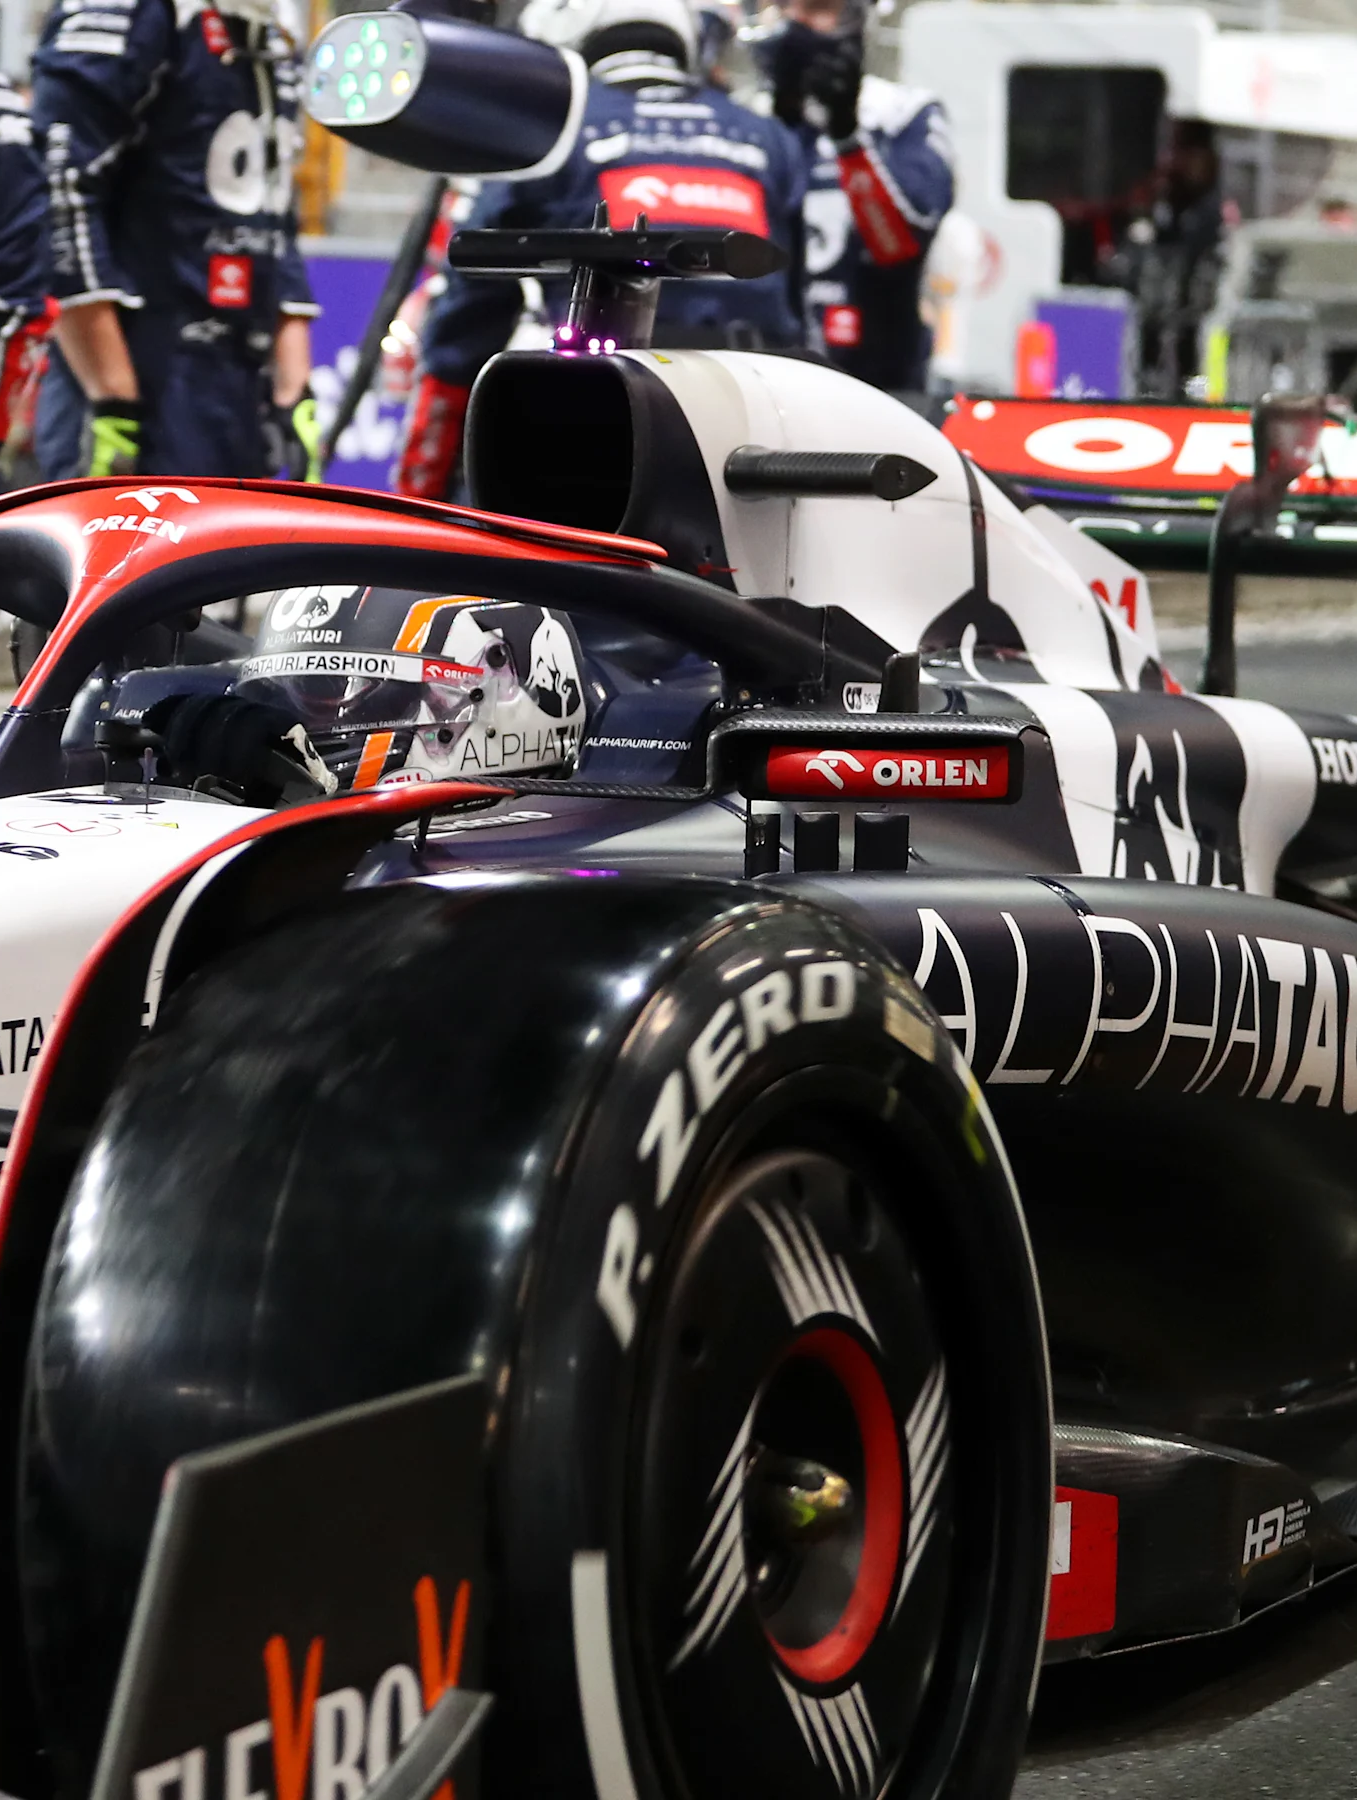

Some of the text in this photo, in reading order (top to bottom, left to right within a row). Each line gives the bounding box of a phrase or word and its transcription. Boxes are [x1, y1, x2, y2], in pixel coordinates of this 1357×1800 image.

[81, 514, 187, 544] ORLEN
[115, 708, 150, 720] ALPH
[872, 758, 988, 787] ORLEN
[1311, 736, 1357, 786] HO
